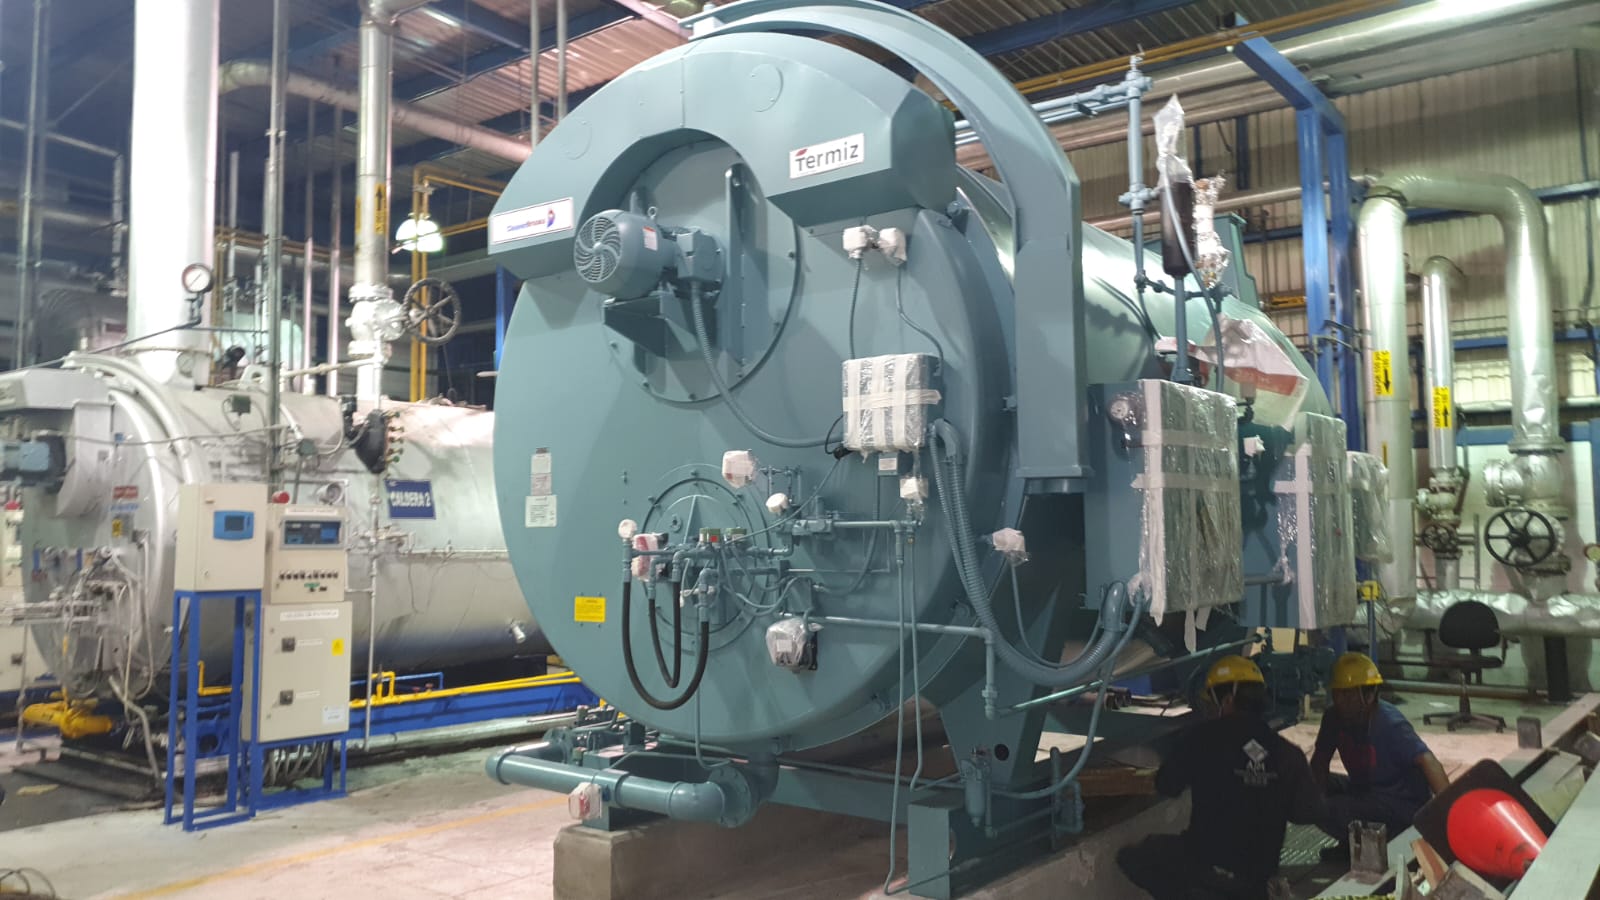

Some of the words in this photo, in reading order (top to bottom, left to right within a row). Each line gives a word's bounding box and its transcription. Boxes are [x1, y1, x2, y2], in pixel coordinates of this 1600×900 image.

[795, 141, 859, 172] Termiz
[390, 491, 424, 507] CALDERA
[424, 491, 431, 507] 2
